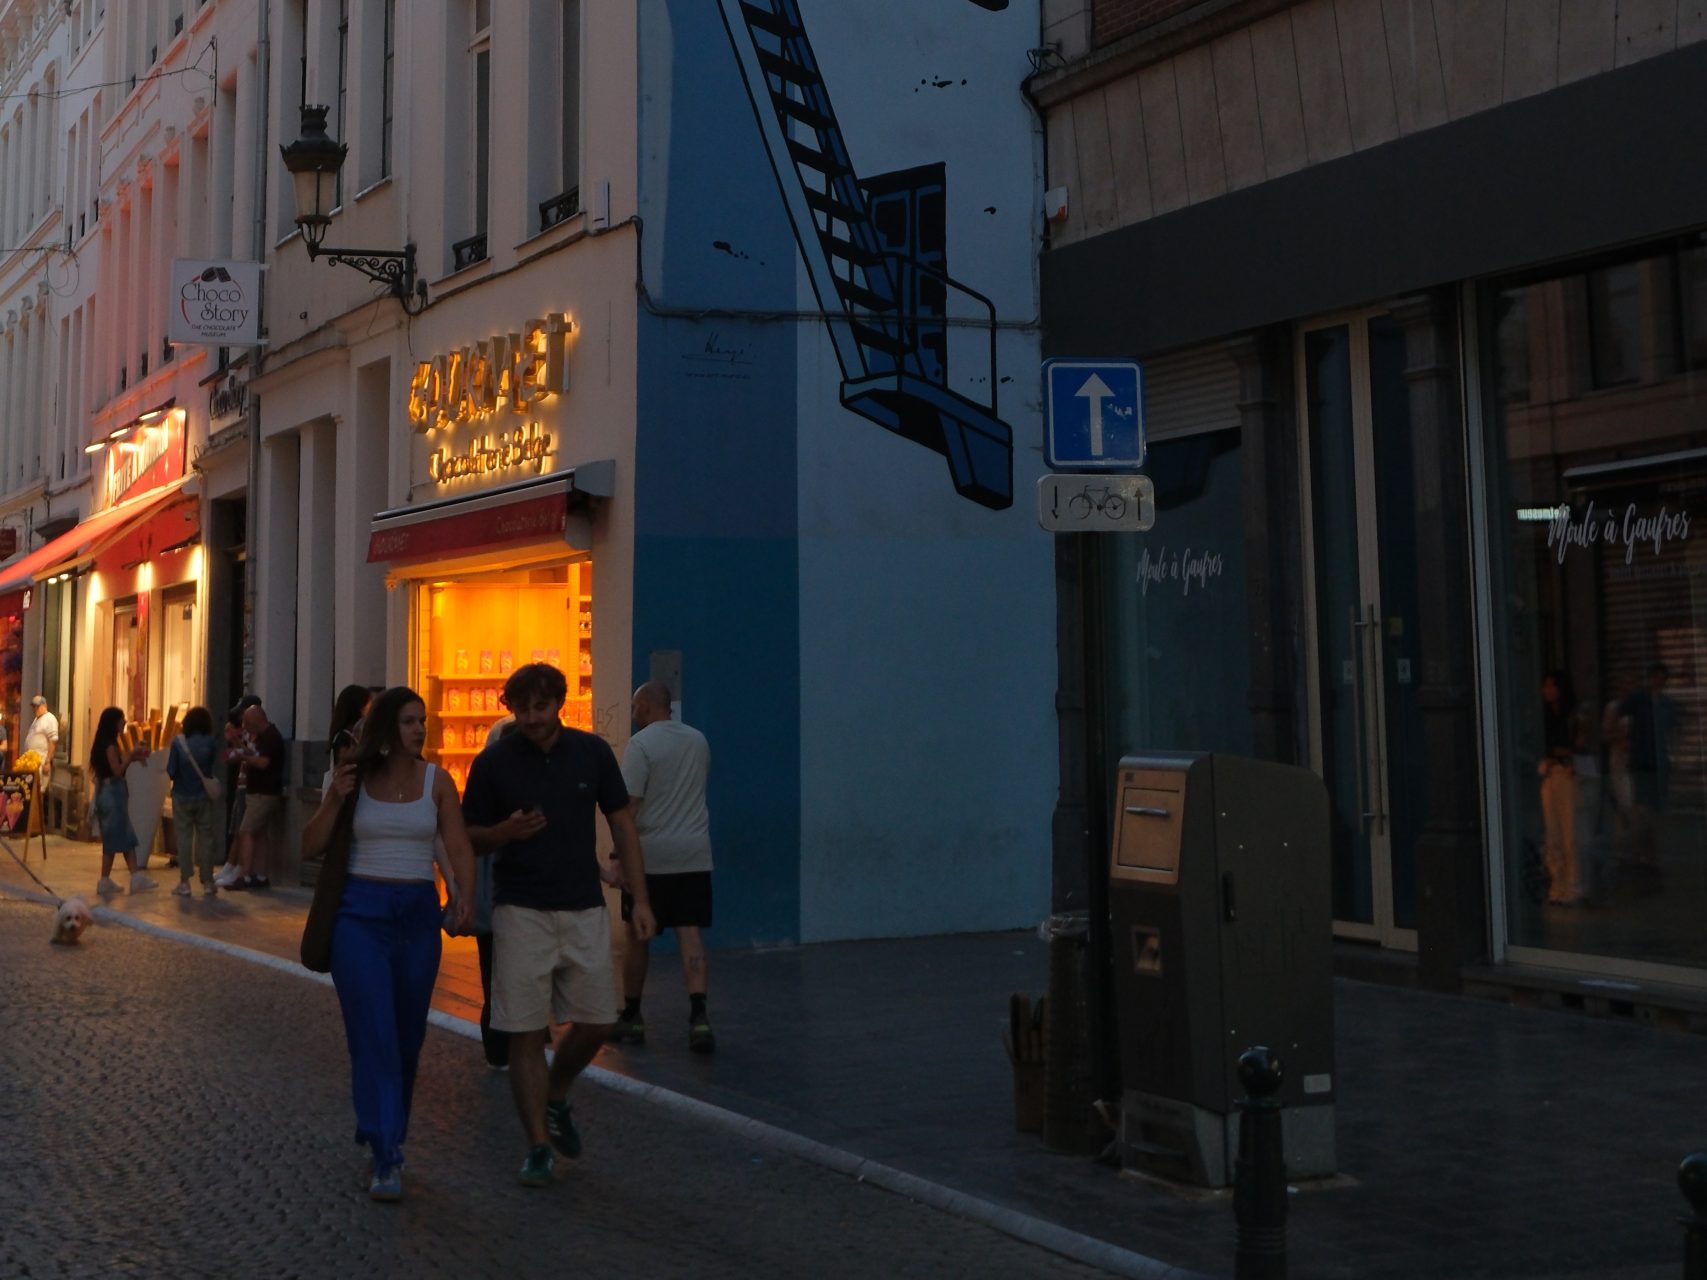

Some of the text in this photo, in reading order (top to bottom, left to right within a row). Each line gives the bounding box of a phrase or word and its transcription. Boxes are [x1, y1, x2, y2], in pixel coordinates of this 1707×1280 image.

[181, 281, 241, 303] Choco
[200, 302, 249, 328] Story
[409, 312, 572, 433] GOURMET
[1547, 499, 1692, 566] Moule à Gaufres
[1182, 547, 1225, 596] Gaufres
